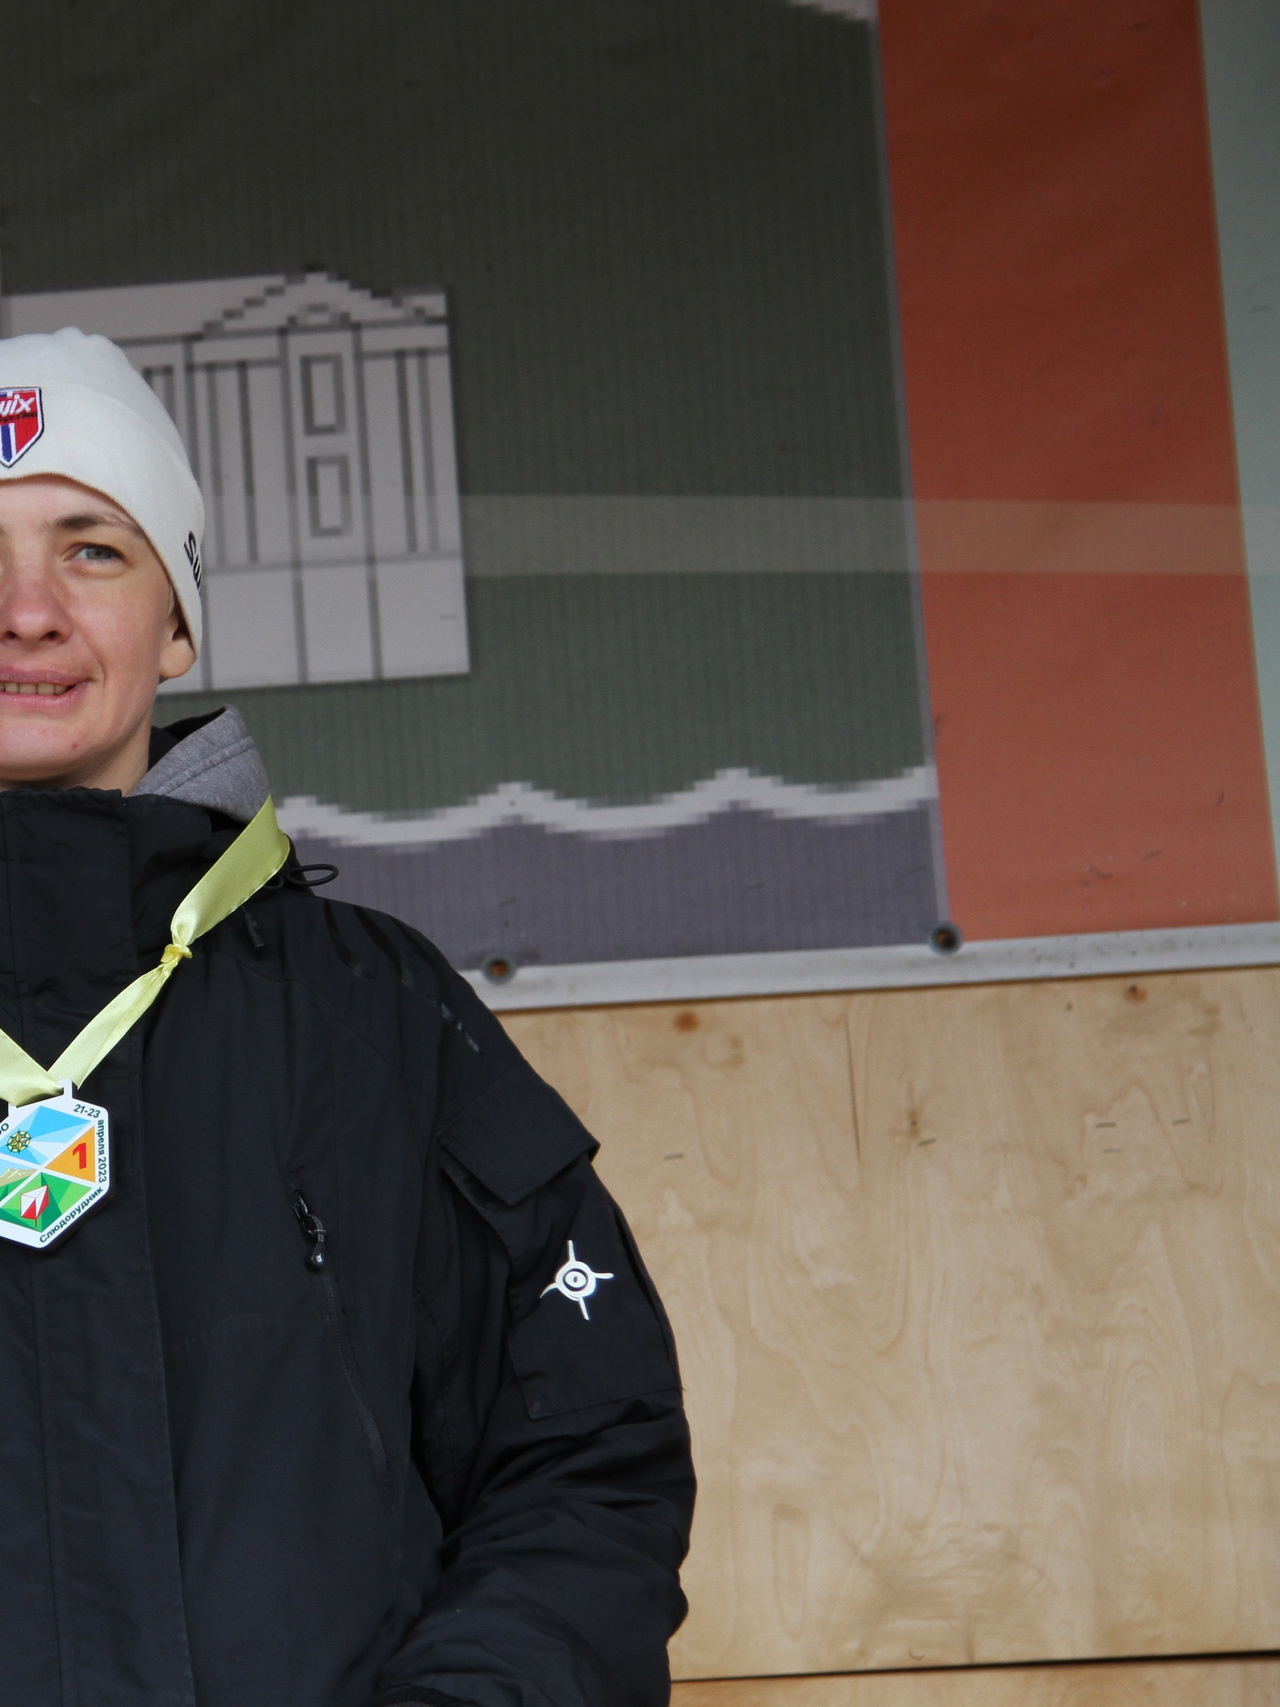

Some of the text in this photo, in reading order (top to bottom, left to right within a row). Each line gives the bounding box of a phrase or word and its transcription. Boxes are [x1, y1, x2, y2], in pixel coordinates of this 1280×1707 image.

[72, 1142, 87, 1170] 1
[73, 1104, 107, 1183] 21-23 апреля 2023
[39, 1186, 104, 1243] Слюдорудник
